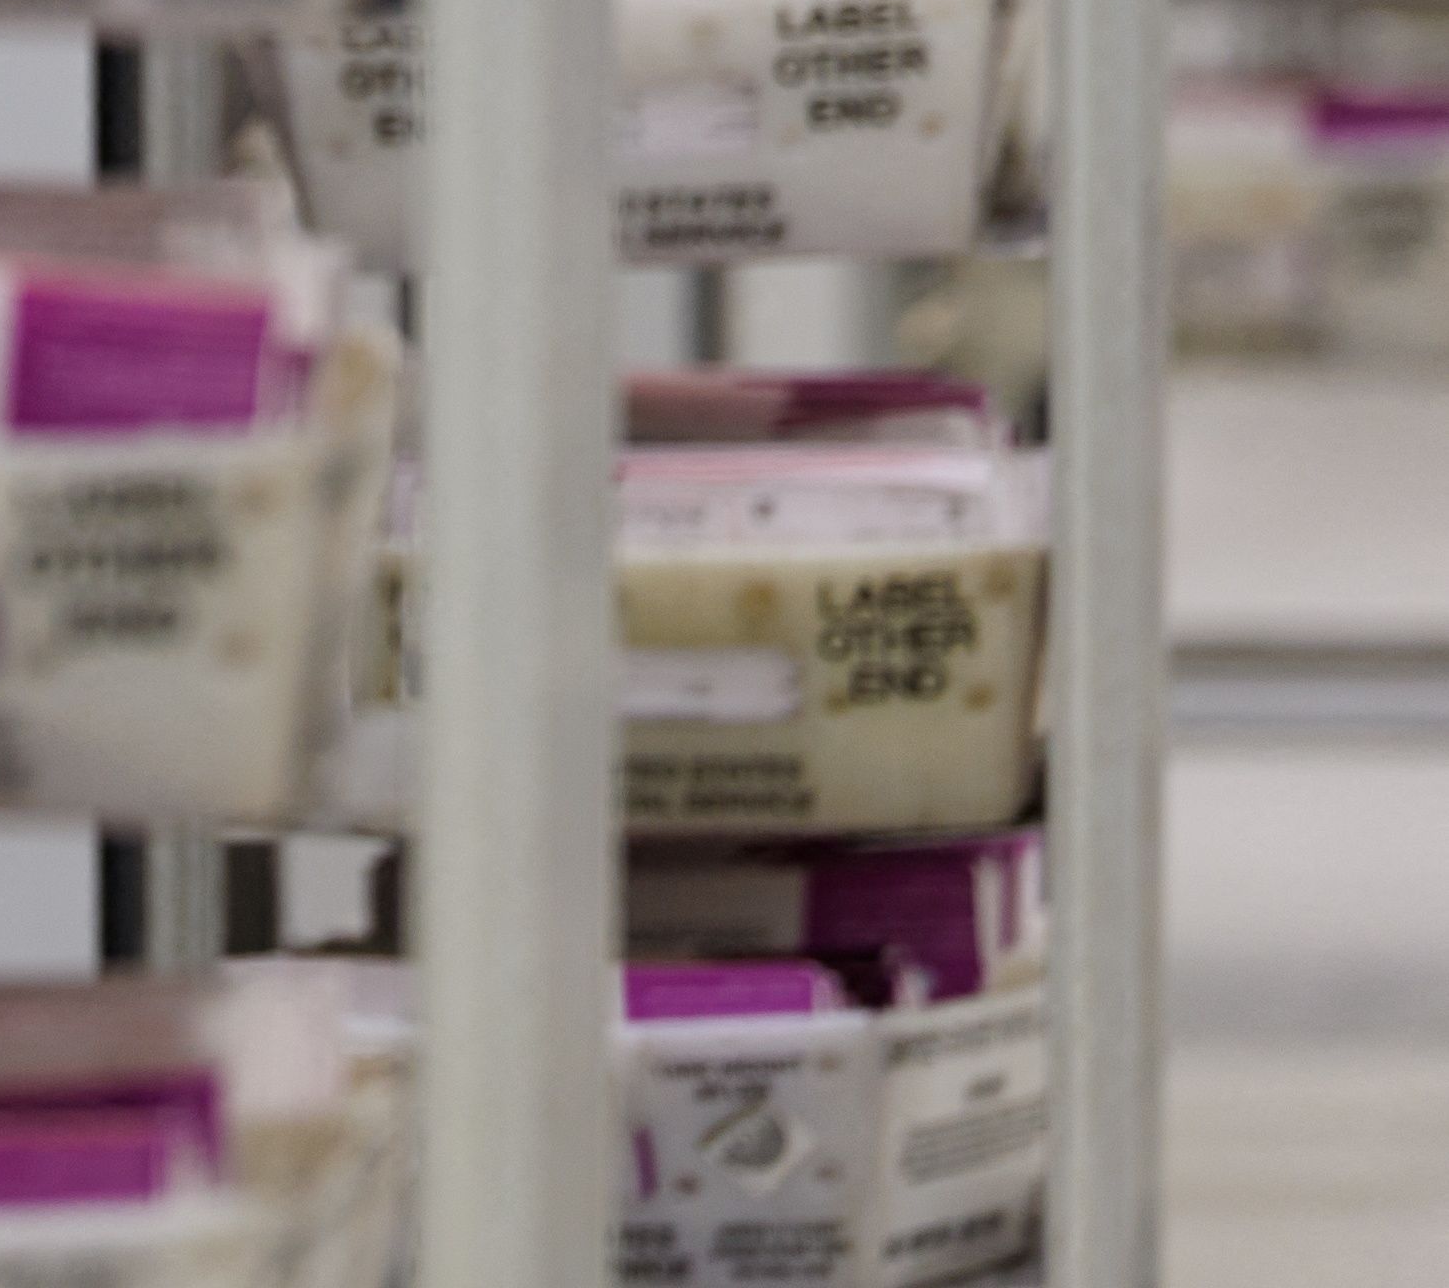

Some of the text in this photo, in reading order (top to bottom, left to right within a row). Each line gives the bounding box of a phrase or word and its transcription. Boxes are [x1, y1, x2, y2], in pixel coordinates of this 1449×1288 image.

[771, 37, 931, 89] OTHER
[806, 88, 901, 133] END
[813, 574, 965, 624] LABEL
[815, 616, 980, 664] OTHER
[847, 661, 948, 704] END
